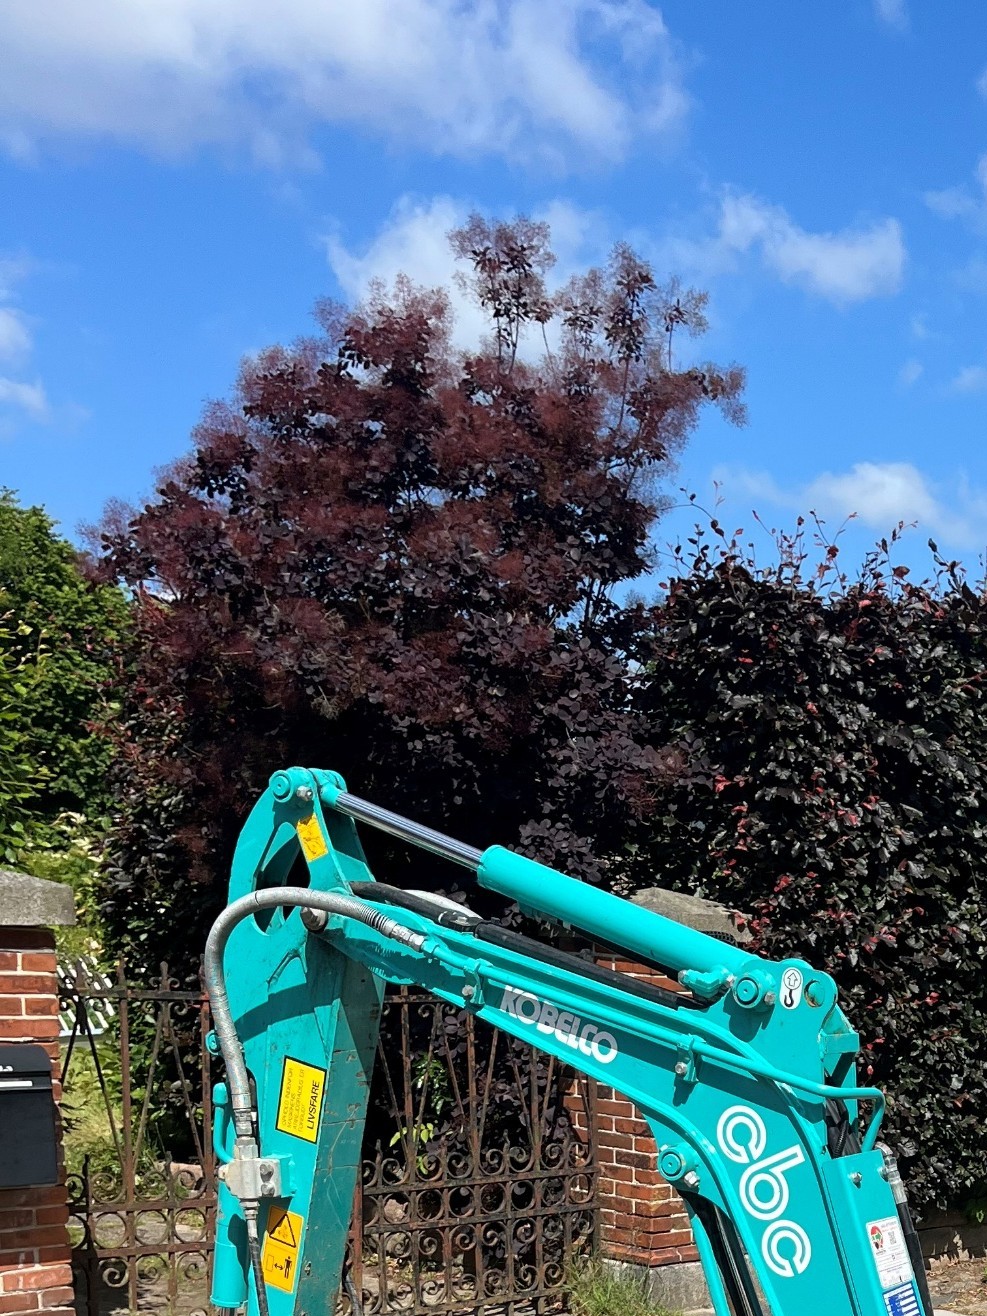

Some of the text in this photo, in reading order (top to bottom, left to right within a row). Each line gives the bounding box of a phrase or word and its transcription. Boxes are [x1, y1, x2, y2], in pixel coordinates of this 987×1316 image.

[500, 985, 618, 1064] KOBELCO
[306, 1080, 320, 1130] LIVSFARE
[716, 1105, 812, 1277] cbc
